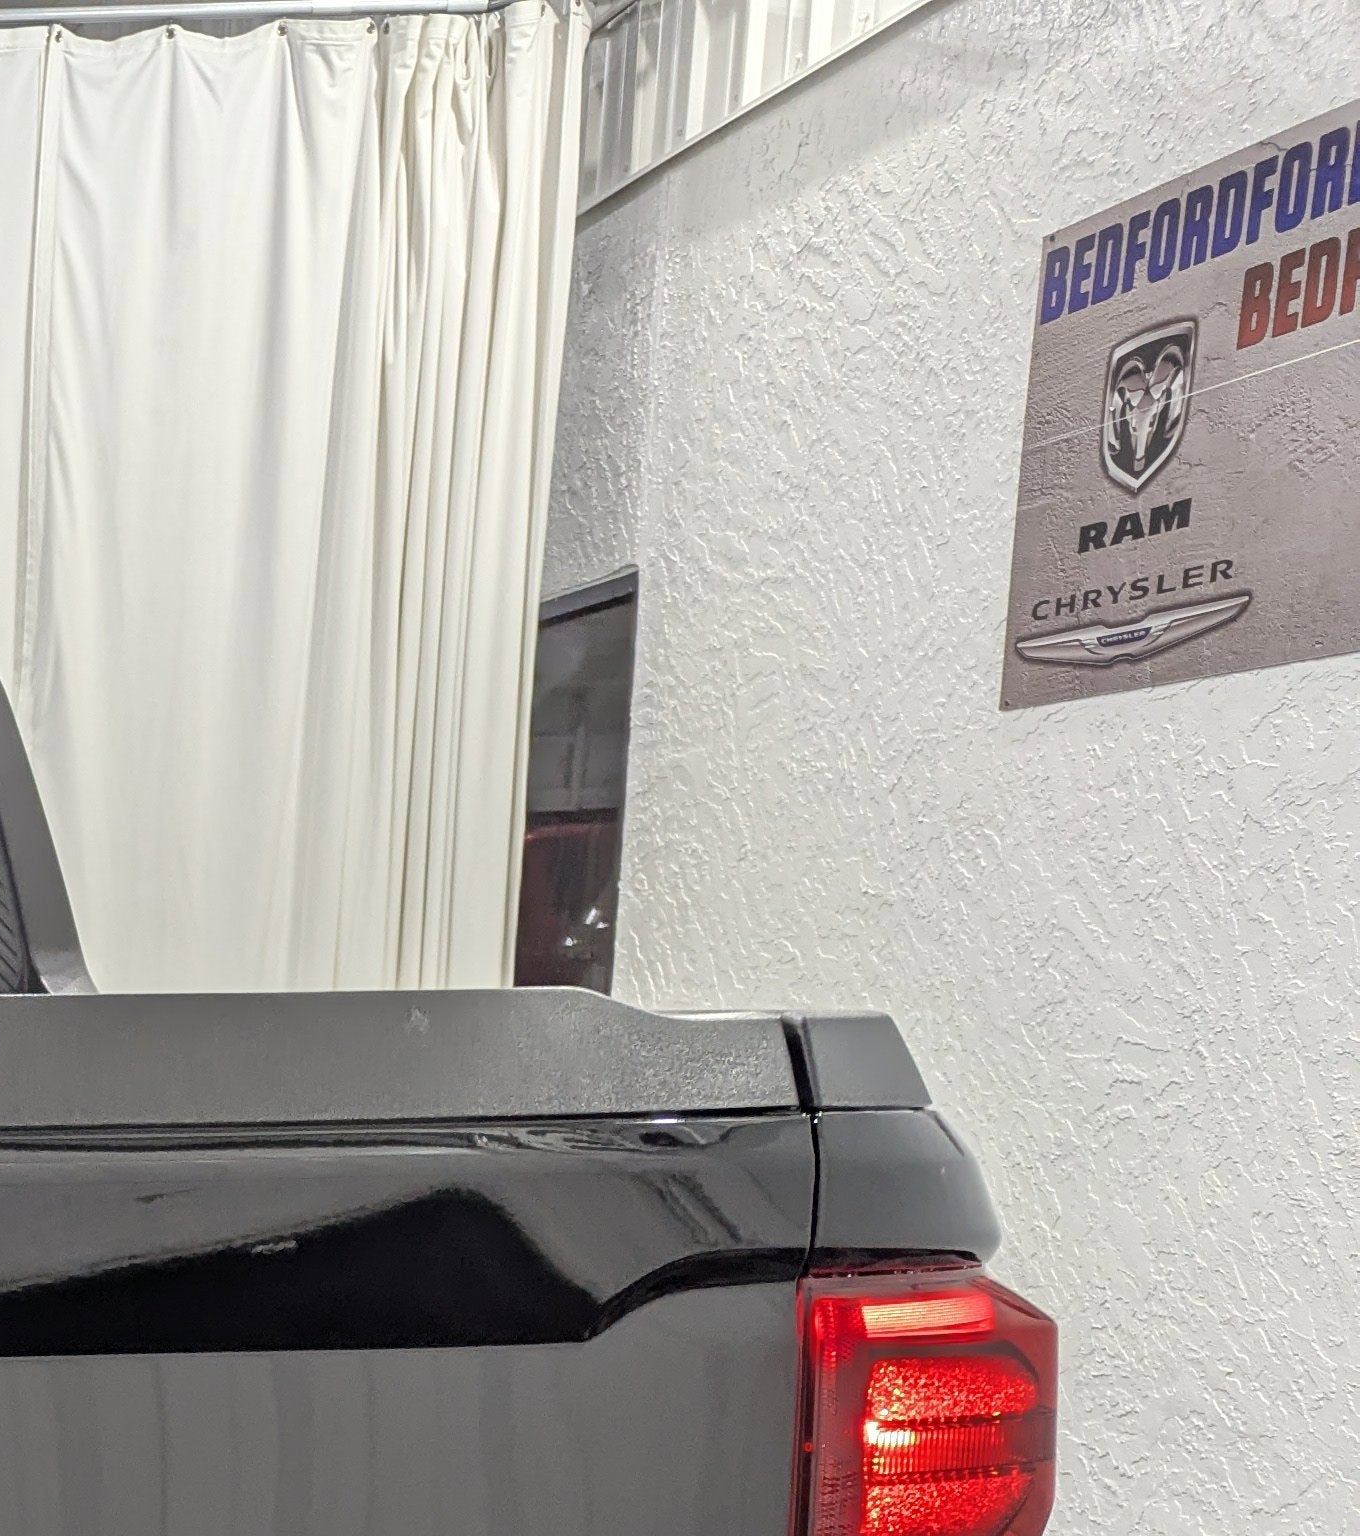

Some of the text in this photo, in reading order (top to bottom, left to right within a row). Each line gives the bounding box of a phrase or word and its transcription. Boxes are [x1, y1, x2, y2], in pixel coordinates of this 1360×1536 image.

[1078, 498, 1192, 553] RAM
[1031, 559, 1234, 621] CHRYSLER
[1100, 630, 1147, 645] CHRYSLER
